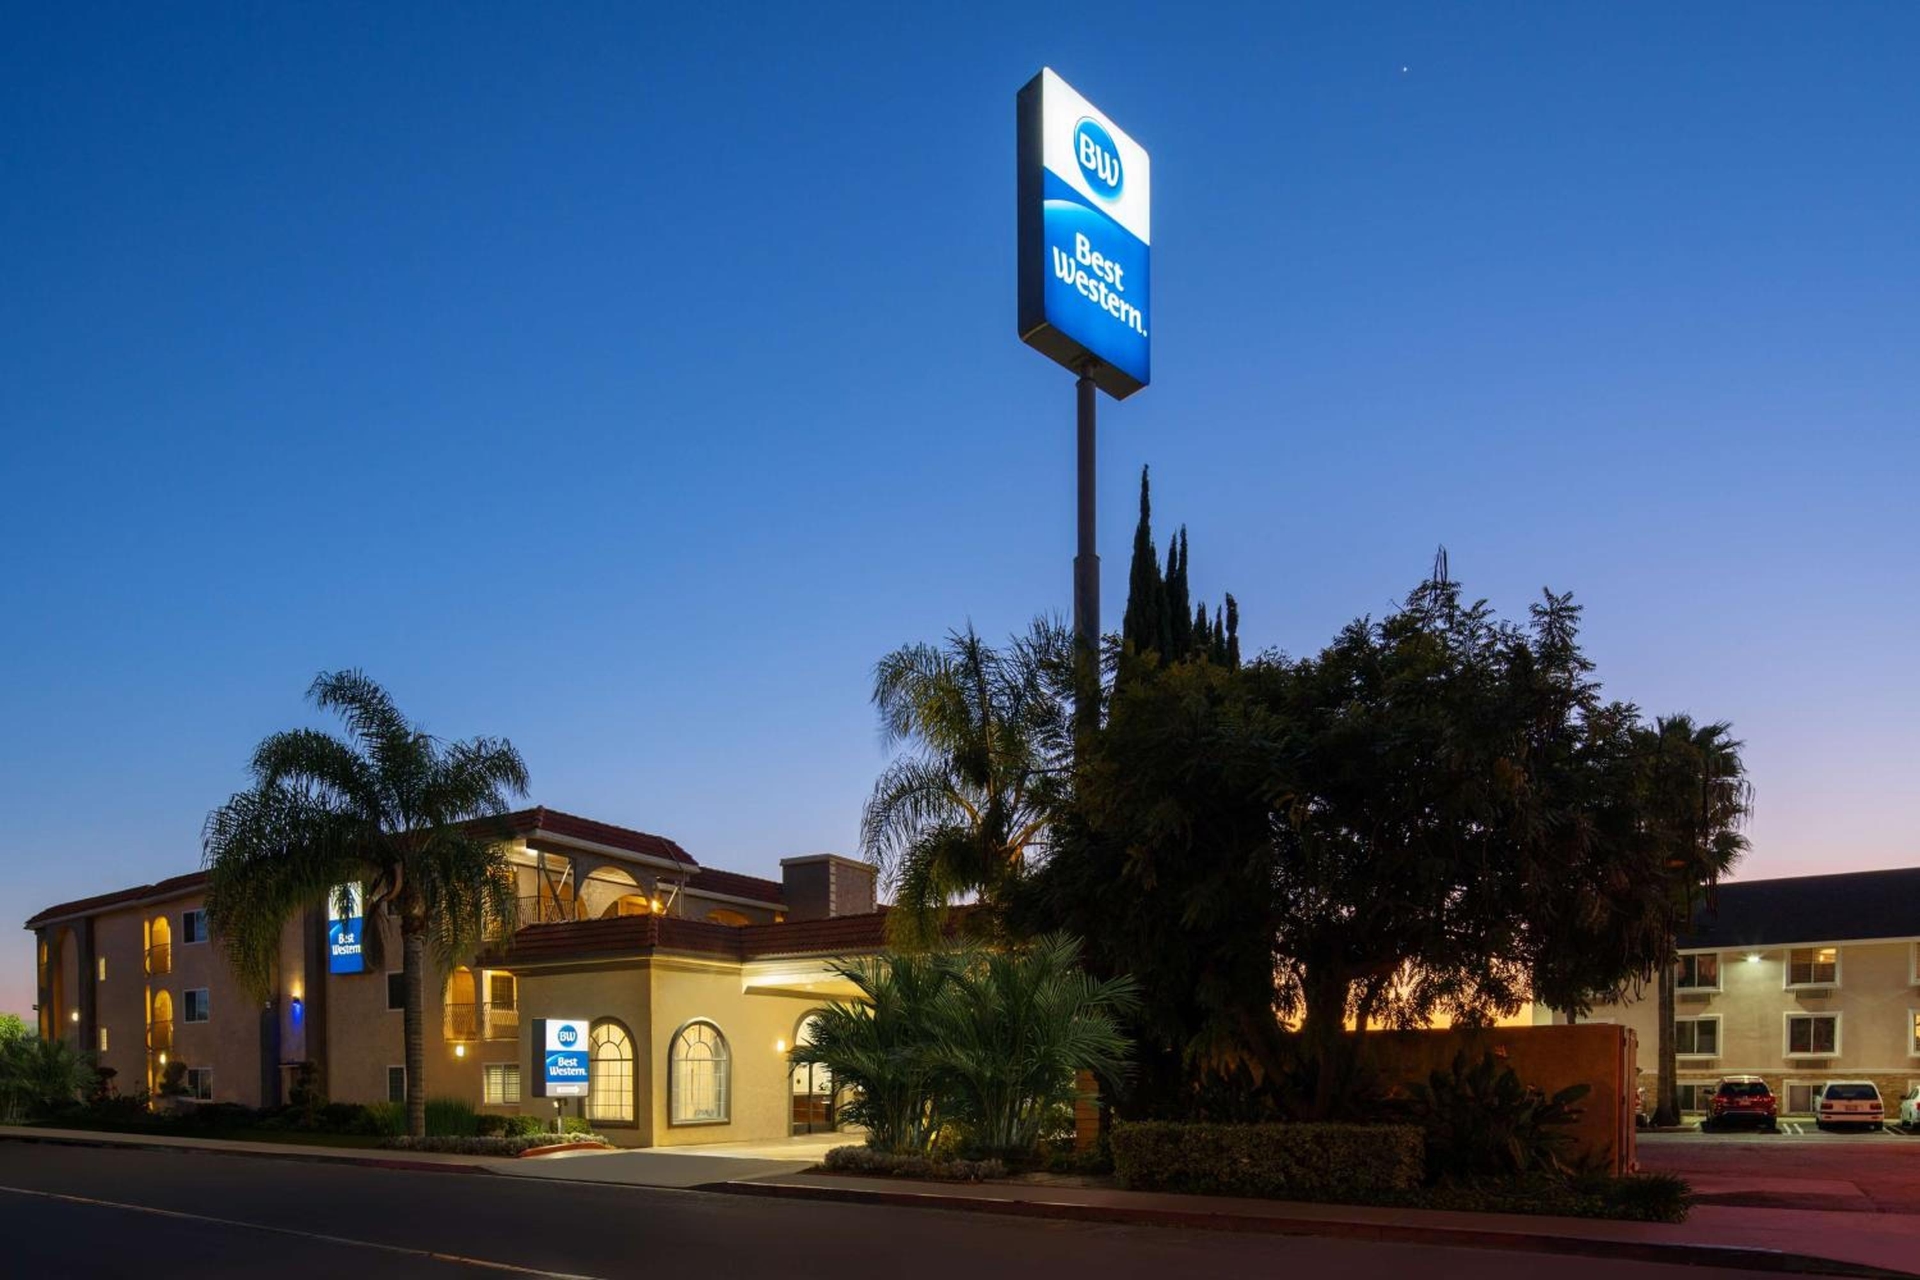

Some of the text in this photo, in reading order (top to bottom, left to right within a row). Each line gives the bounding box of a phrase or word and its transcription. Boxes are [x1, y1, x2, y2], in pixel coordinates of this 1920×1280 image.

[1079, 131, 1120, 189] BW
[1075, 231, 1124, 292] Best
[560, 1031, 576, 1042] BW
[557, 1056, 578, 1067] Best
